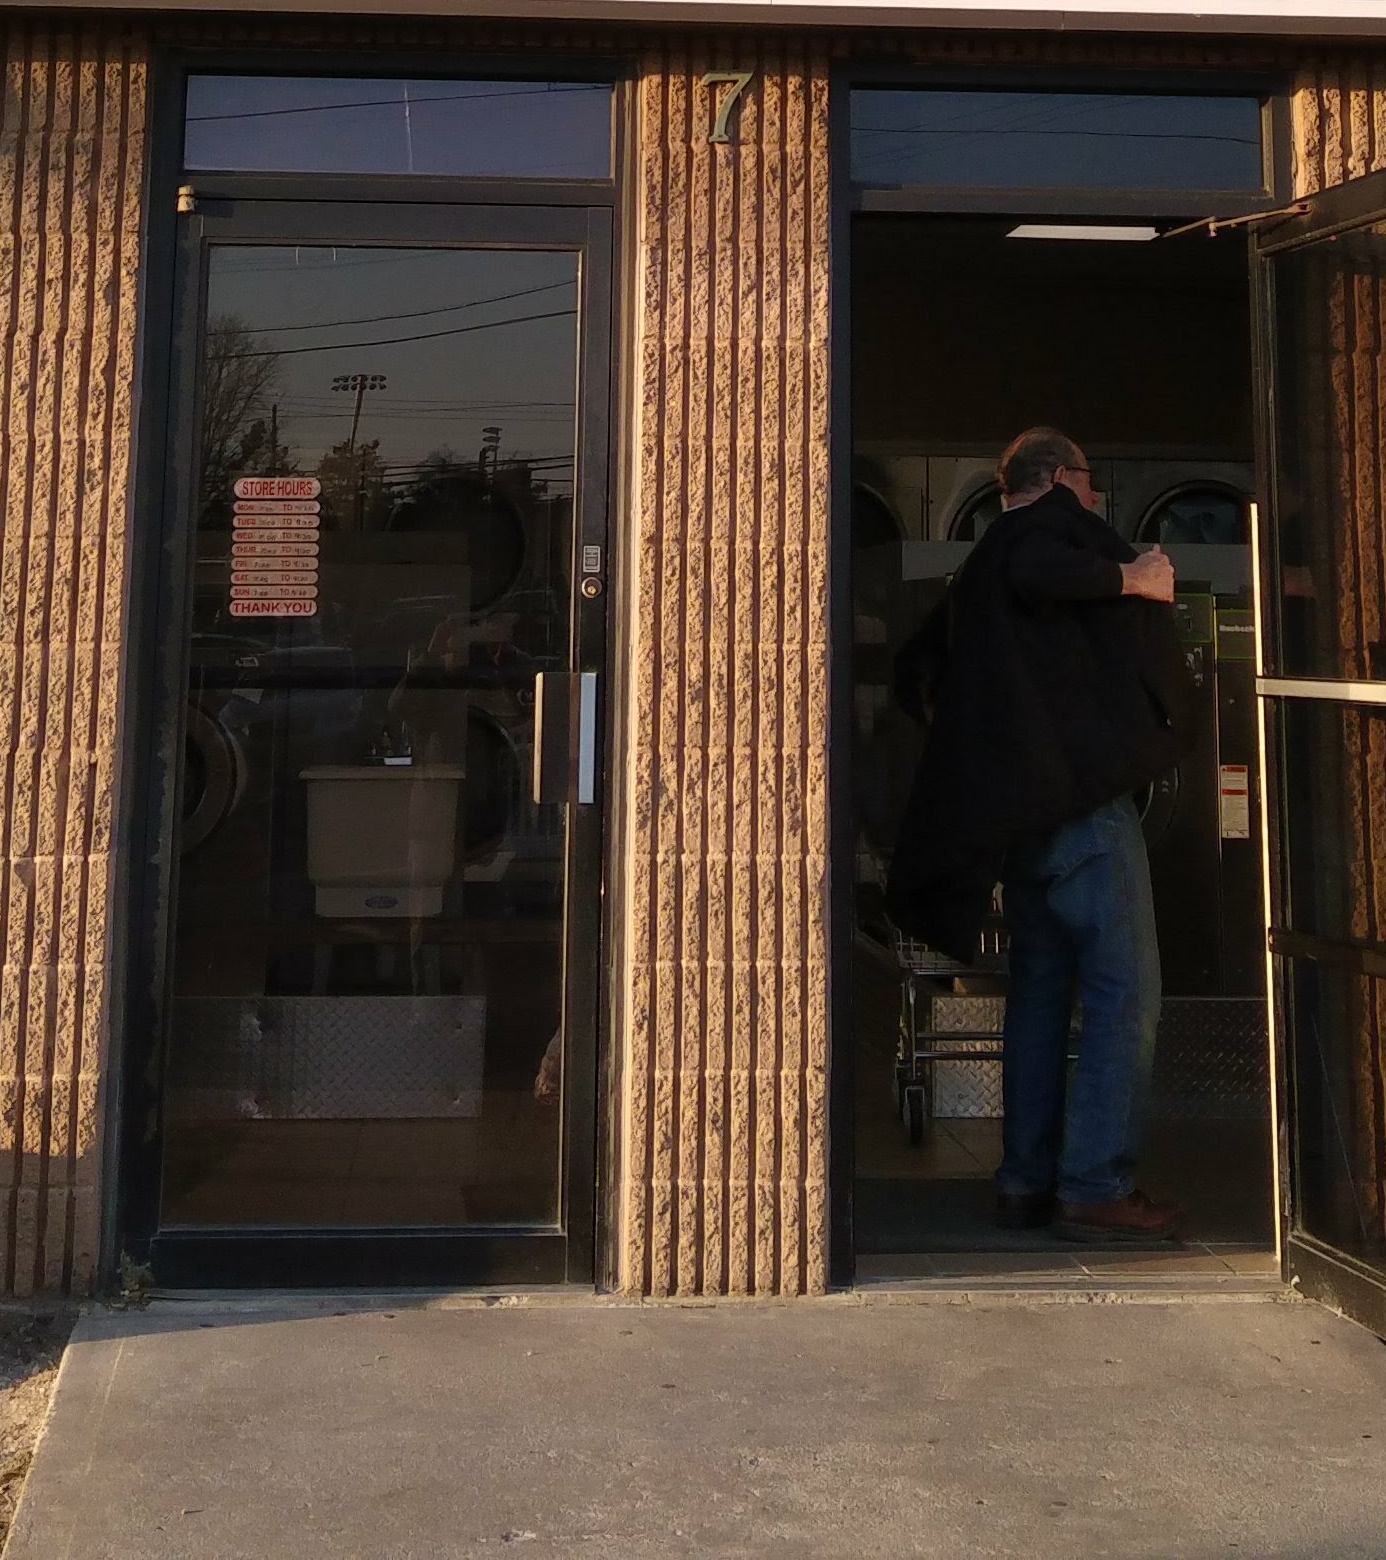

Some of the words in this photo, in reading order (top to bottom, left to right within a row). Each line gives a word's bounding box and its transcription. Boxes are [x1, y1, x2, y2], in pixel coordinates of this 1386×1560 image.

[701, 71, 755, 144] 7
[242, 480, 275, 496] STORE
[277, 480, 313, 497] HOURS
[283, 502, 293, 512] TO
[282, 517, 292, 526] TO
[236, 531, 254, 540] WED
[282, 531, 292, 540] TO
[281, 545, 292, 554] TO
[235, 559, 247, 568] FRI
[280, 559, 291, 568] TO
[234, 573, 249, 582] SAT
[280, 573, 290, 583] TO
[234, 587, 250, 597] SUN
[279, 587, 290, 597] TO
[232, 601, 280, 613] THANK
[283, 601, 313, 613] YOU
